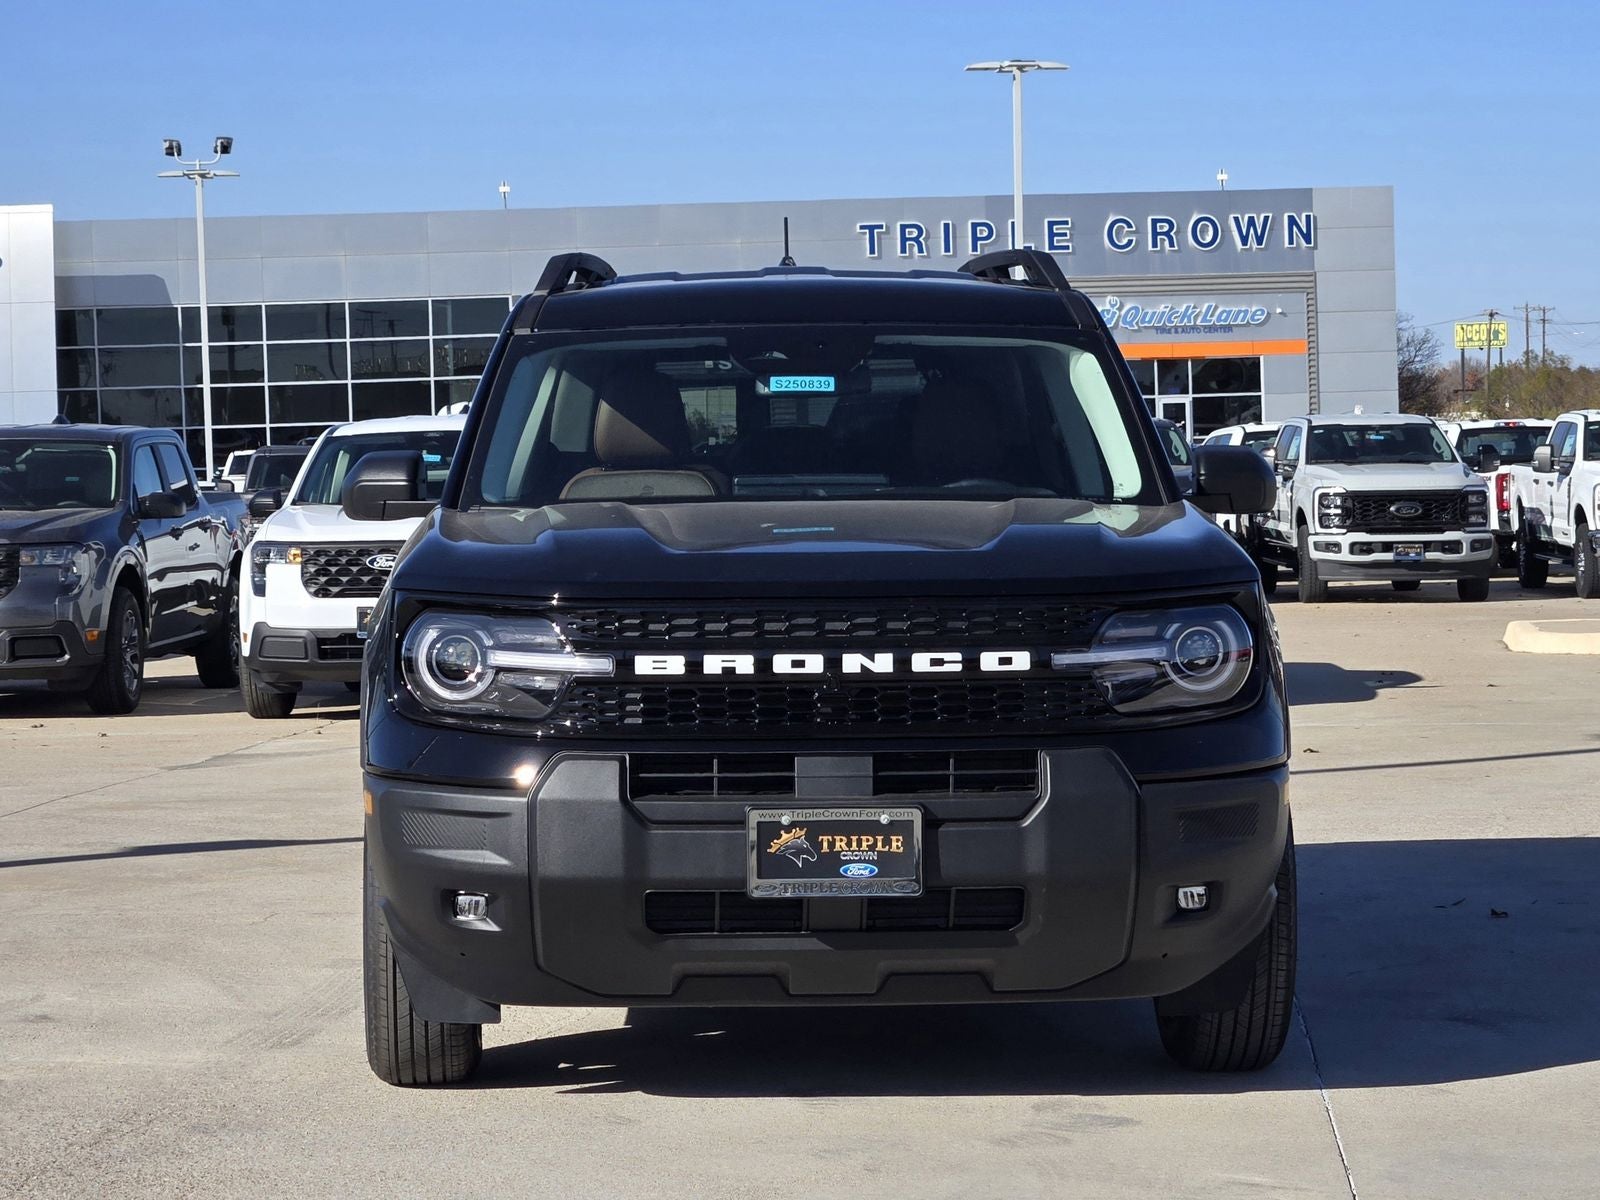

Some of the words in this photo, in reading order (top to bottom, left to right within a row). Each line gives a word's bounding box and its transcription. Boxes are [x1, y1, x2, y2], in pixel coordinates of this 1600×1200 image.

[857, 216, 1073, 257] TRIPLE
[1105, 211, 1316, 253] CROWN
[1121, 303, 1199, 329] Quick
[1197, 302, 1268, 326] Lane
[1155, 327, 1172, 335] TIRE
[1180, 327, 1202, 335] AUTO
[1203, 326, 1234, 334] CENTER
[774, 379, 831, 389] S250839
[373, 556, 395, 567] For
[634, 650, 1031, 675] BRONCO
[758, 809, 914, 819] wwwTripleCrownFordcom
[818, 835, 904, 853] TRIPLE
[839, 851, 878, 861] CROWN
[847, 864, 871, 875] Ford
[780, 882, 838, 894] TRIPLE
